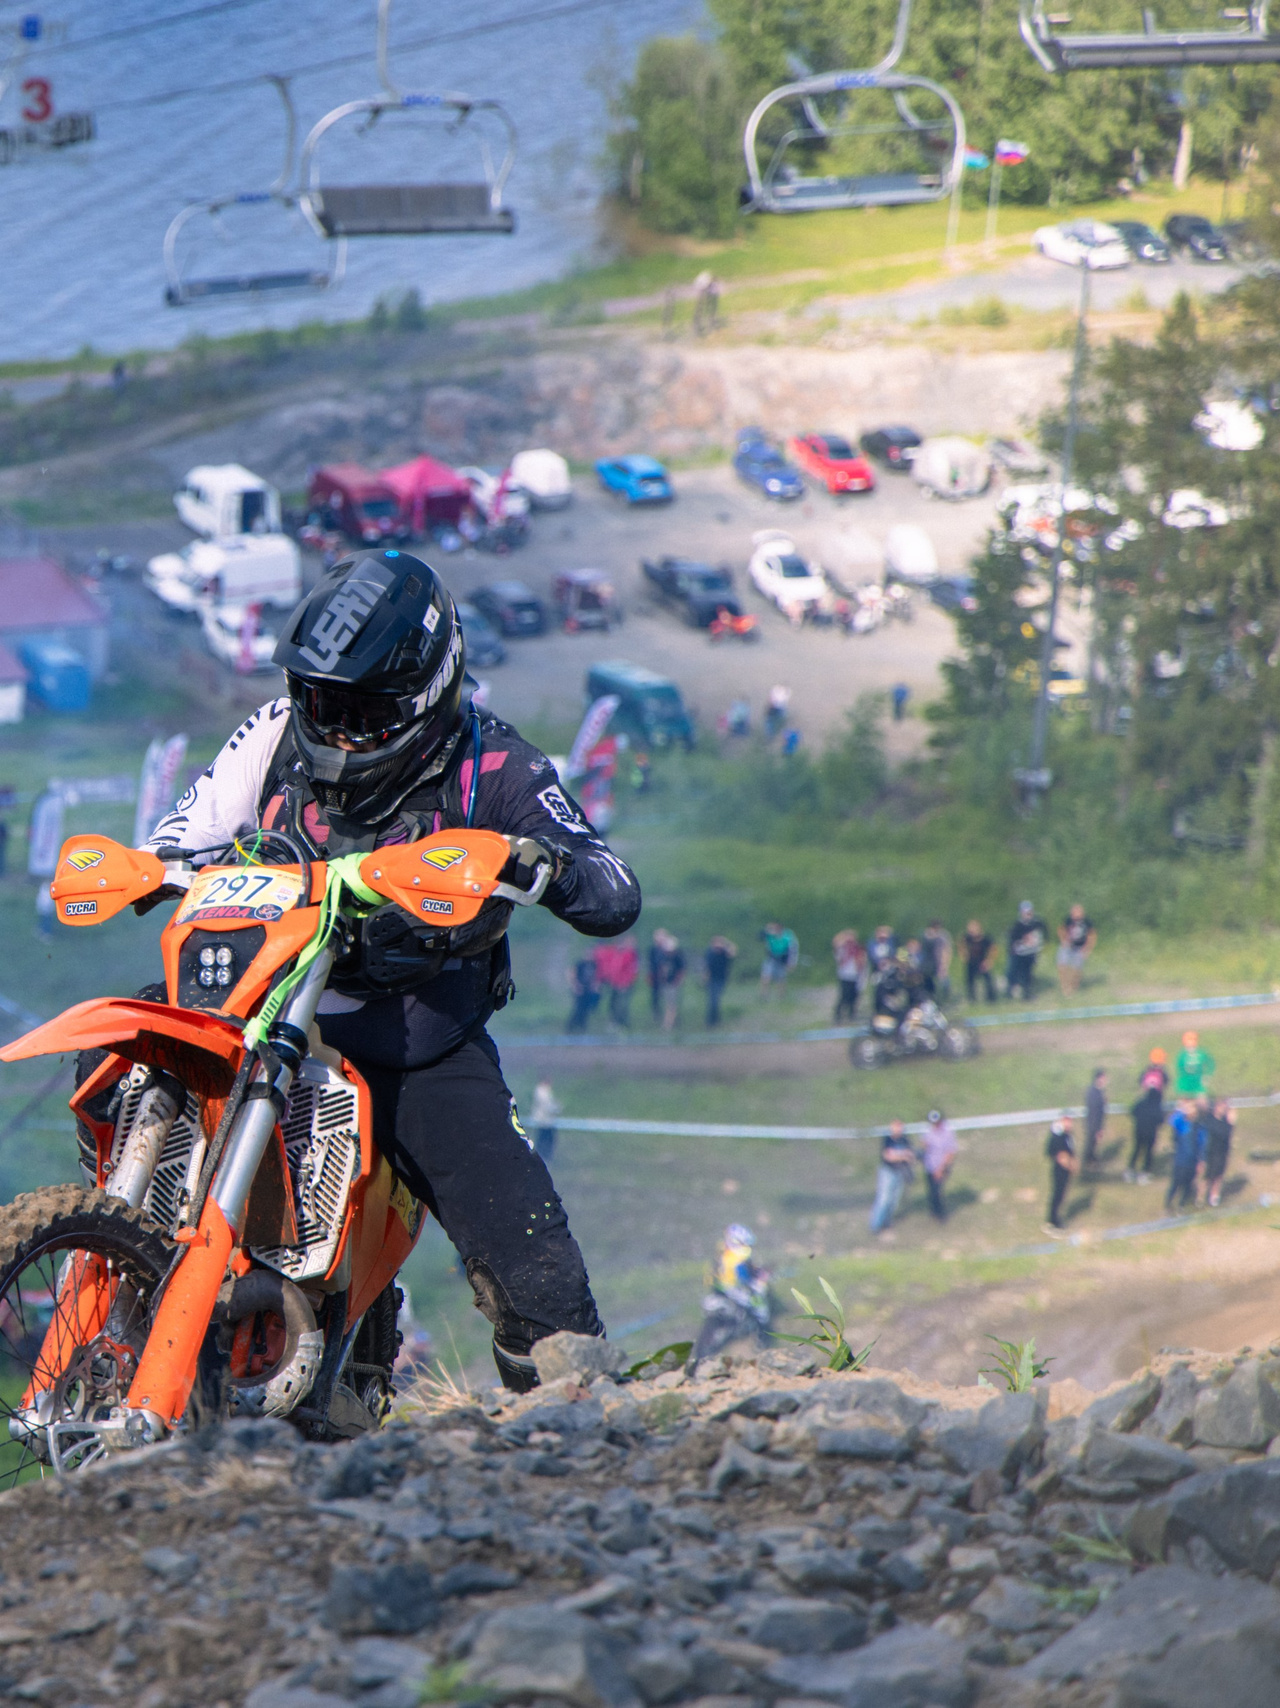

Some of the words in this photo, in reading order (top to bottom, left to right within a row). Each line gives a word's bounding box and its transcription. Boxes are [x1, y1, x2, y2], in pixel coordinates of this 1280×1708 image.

[22, 77, 52, 122] 3
[411, 626, 462, 716] 100%
[200, 875, 274, 906] 297
[66, 902, 96, 914] CYCRA
[193, 906, 251, 920] KENDA
[422, 899, 453, 913] CYCRA
